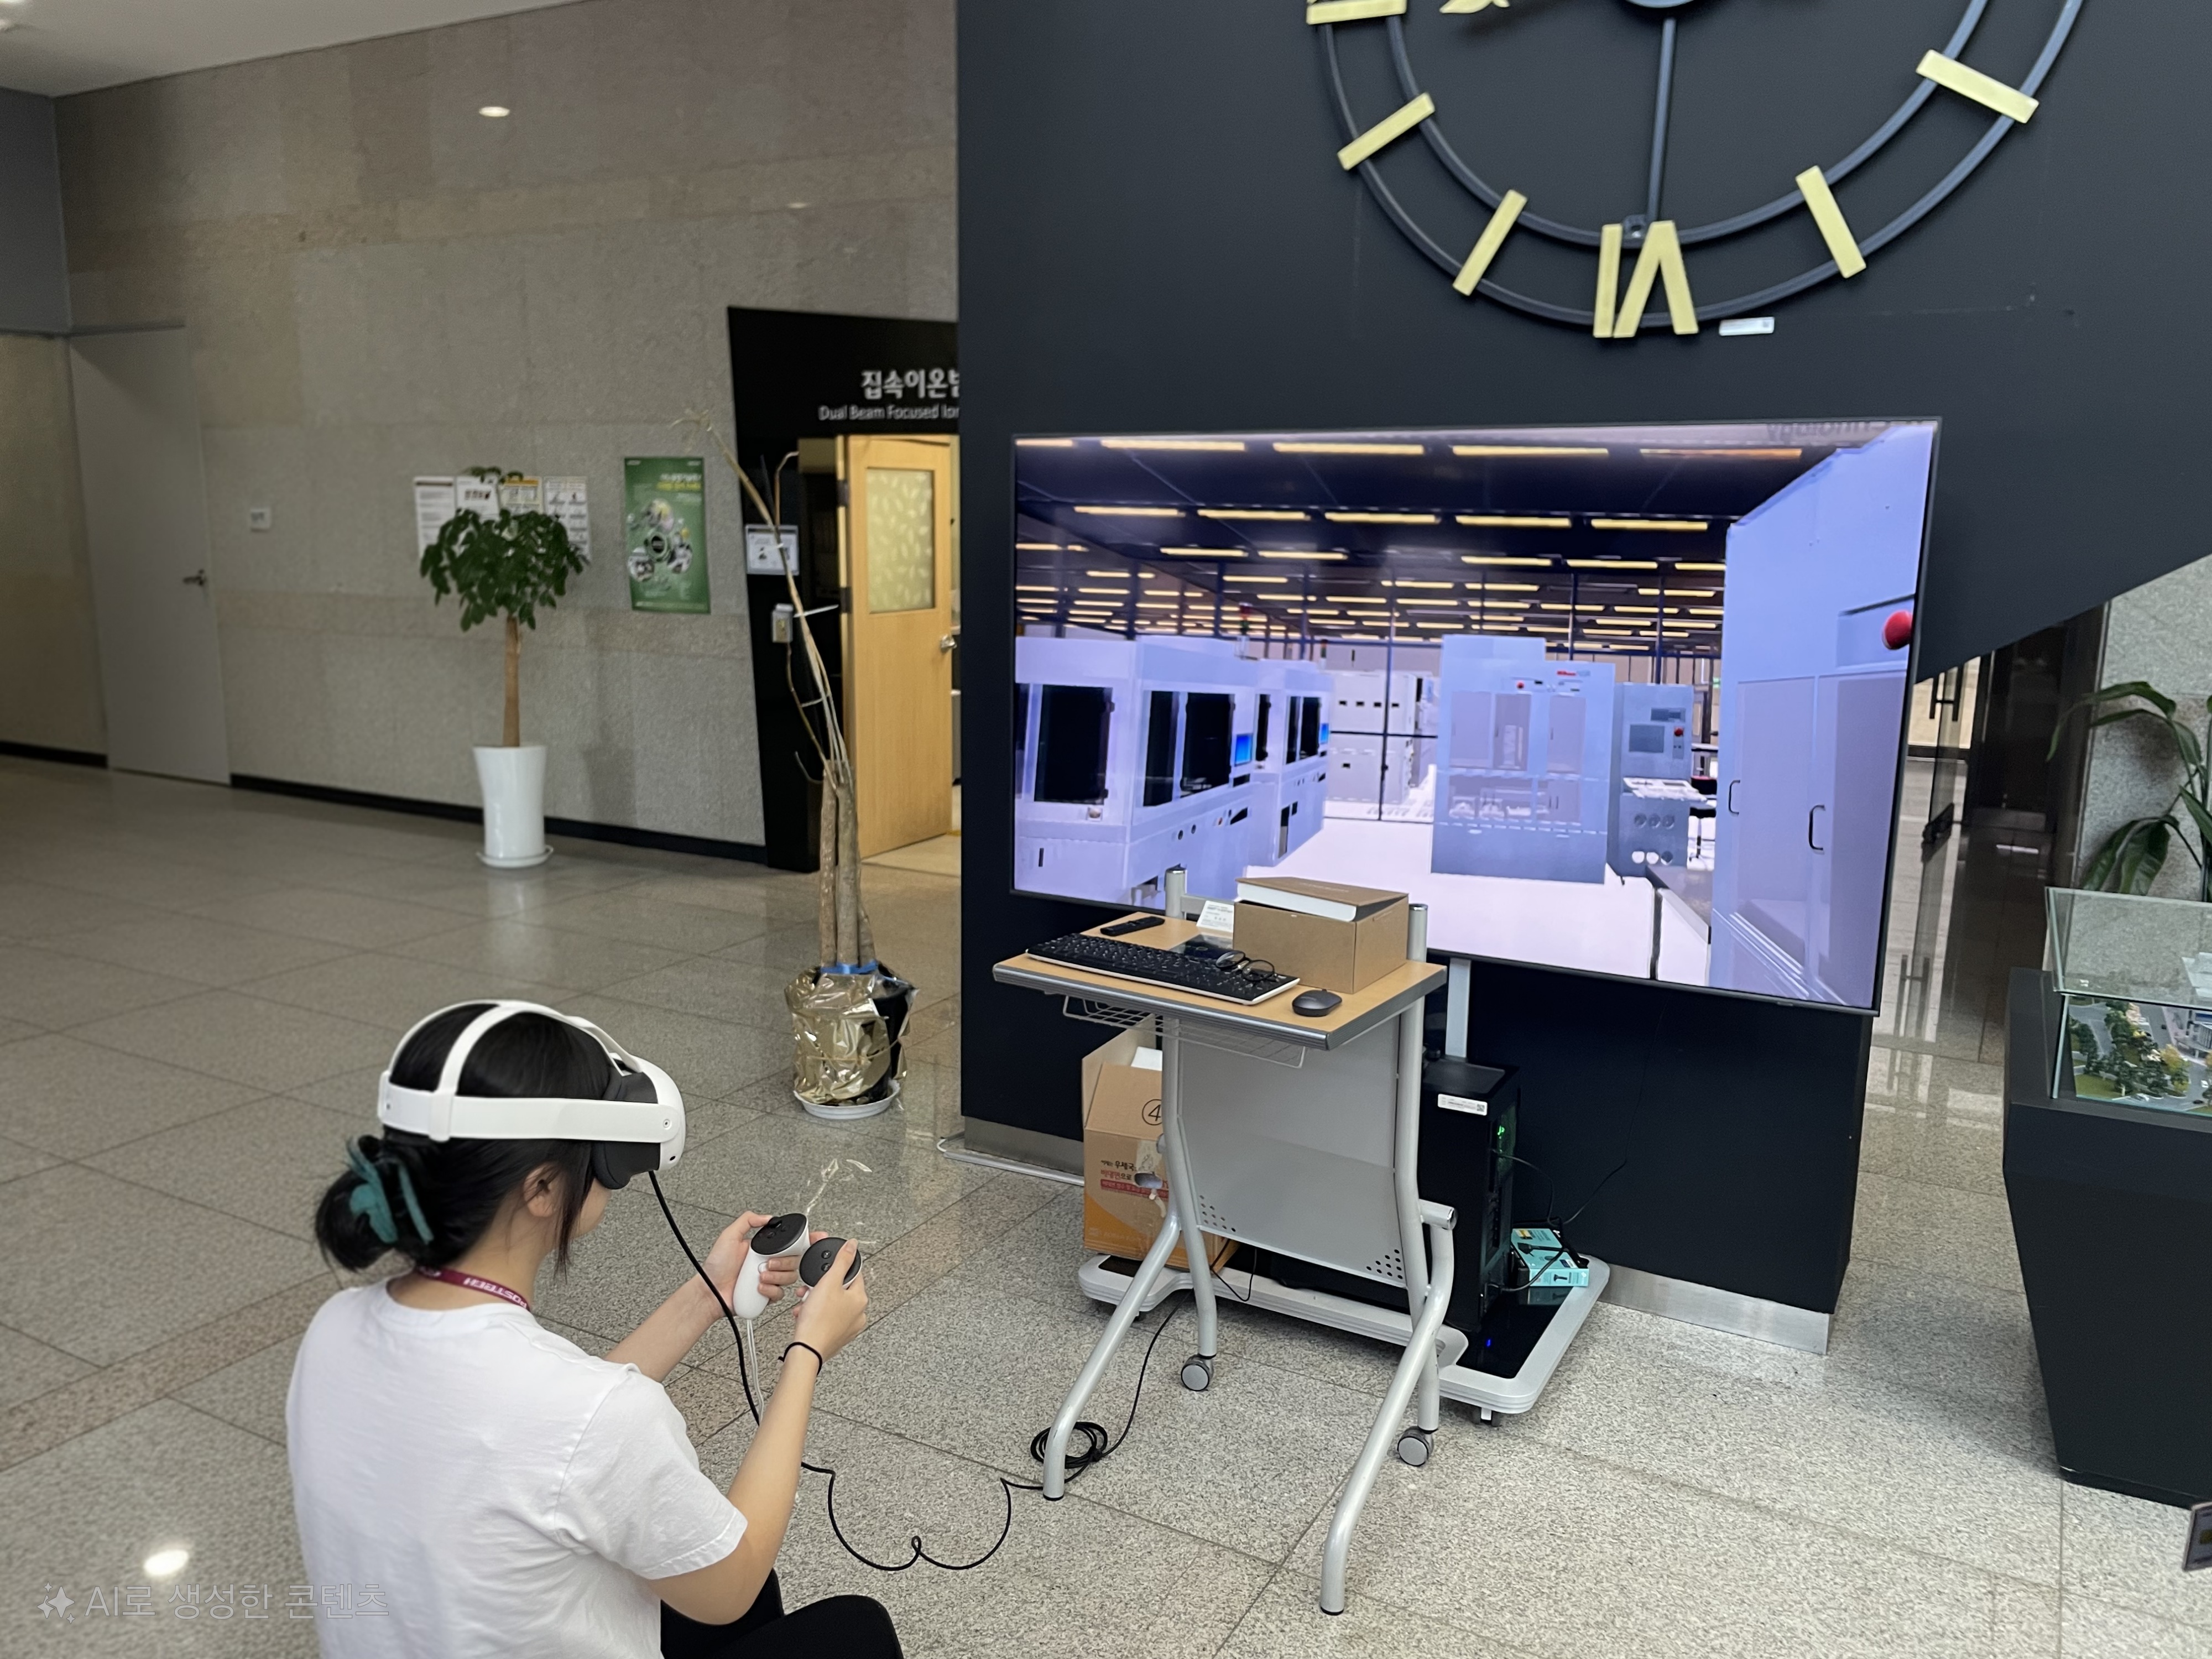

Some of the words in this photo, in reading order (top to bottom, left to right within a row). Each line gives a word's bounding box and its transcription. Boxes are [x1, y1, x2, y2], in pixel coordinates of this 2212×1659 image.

[818, 405, 847, 420] Dual
[849, 404, 885, 420] Beam
[886, 404, 940, 419] Focused
[463, 1277, 527, 1308] POSTECH
